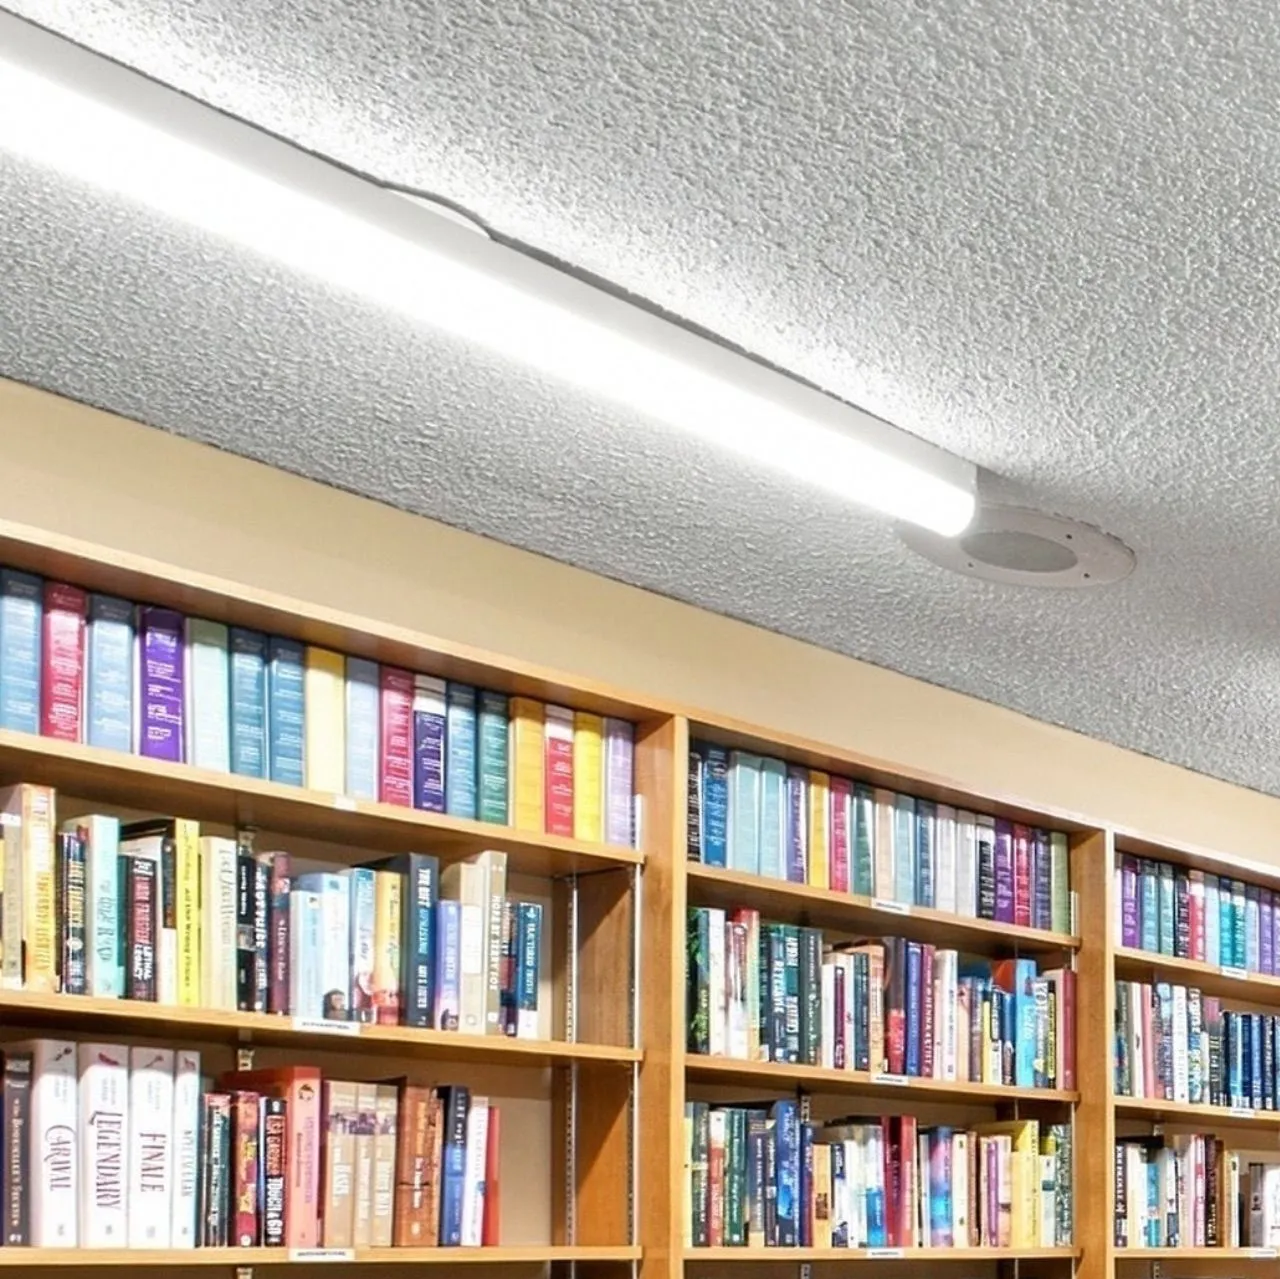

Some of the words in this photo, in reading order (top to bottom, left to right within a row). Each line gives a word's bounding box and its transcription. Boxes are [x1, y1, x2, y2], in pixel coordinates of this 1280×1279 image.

[43, 1124, 76, 1193] CARAVAL
[89, 1110, 124, 1211] LEGENDARY
[139, 1132, 167, 1193] FINALE
